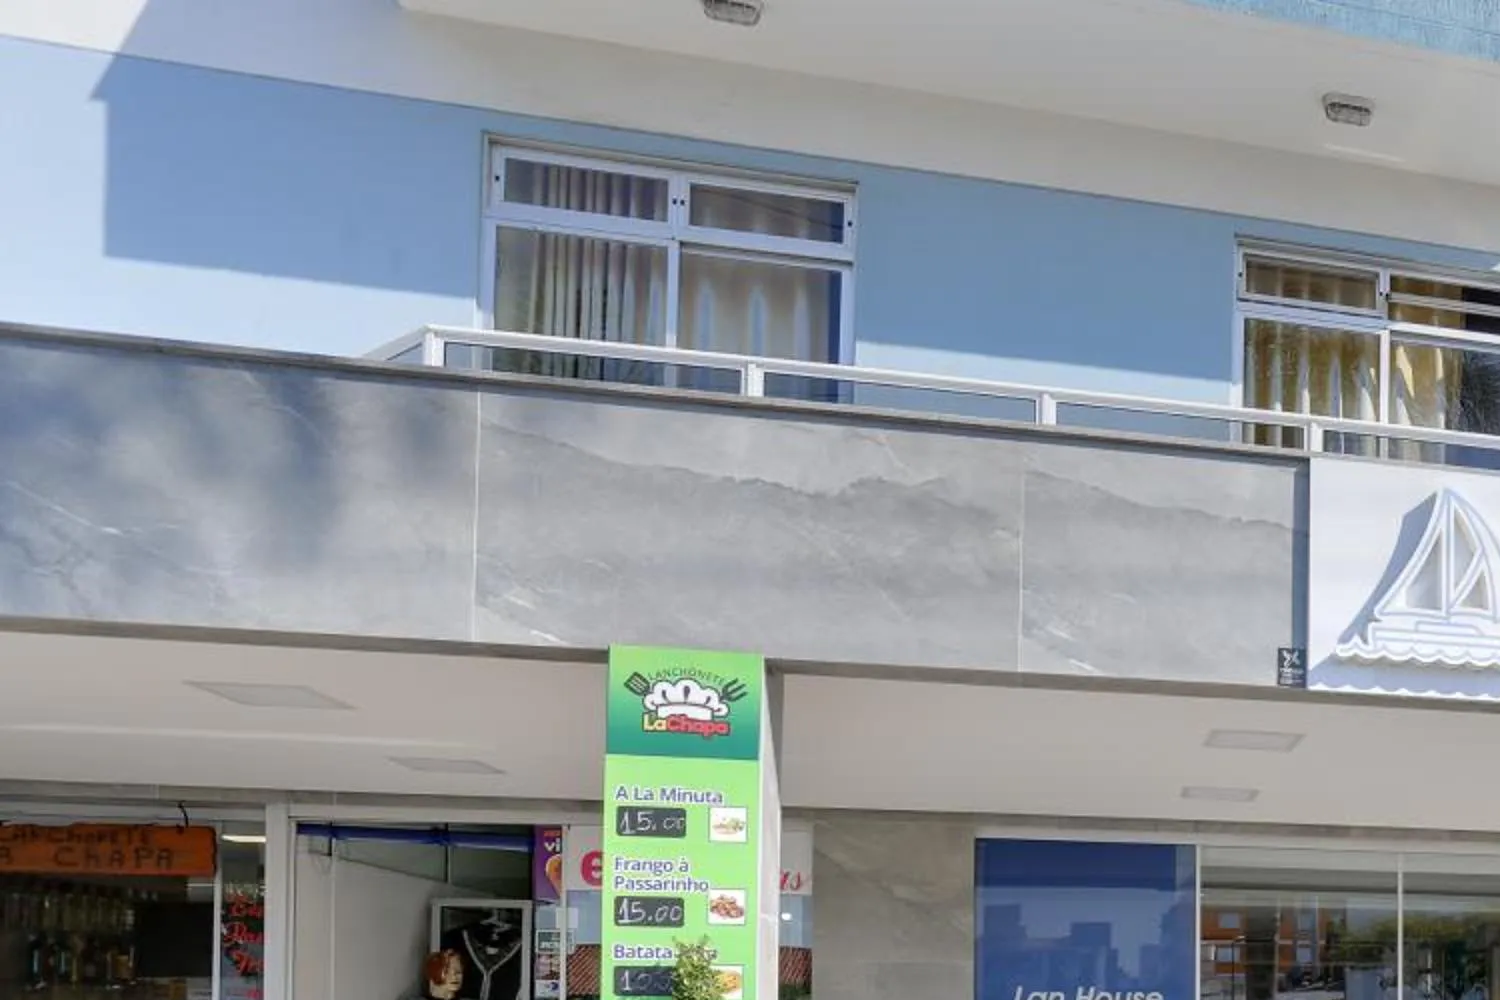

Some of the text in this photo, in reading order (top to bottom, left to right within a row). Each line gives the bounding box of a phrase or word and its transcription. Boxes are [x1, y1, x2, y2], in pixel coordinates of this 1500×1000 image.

[615, 785, 723, 804] A La Minuta
[614, 857, 674, 875] Frango
[614, 876, 710, 892] Passarinho
[617, 898, 682, 924] 15.00
[613, 943, 673, 960] Batata
